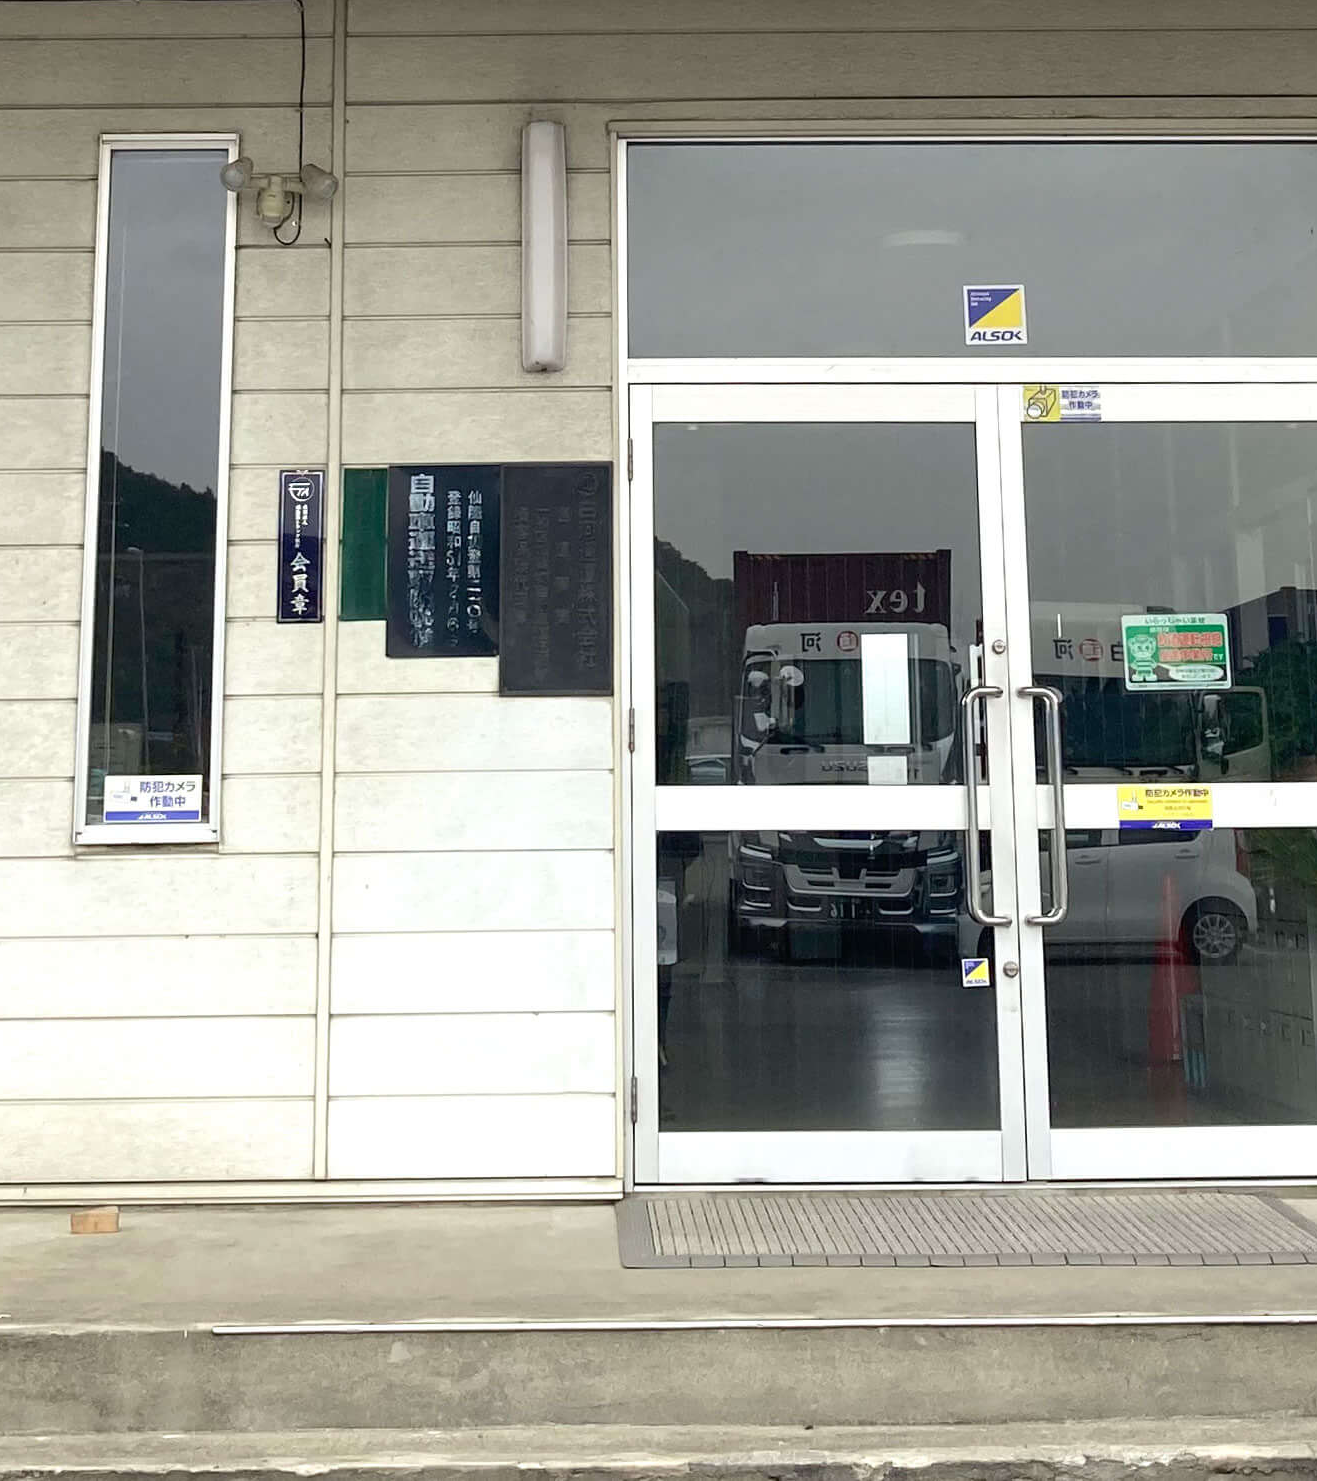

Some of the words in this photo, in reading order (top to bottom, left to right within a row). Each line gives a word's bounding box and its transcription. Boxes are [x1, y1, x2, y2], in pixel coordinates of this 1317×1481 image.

[970, 330, 1024, 342] ALSOK
[289, 551, 311, 616] 会員章
[140, 781, 195, 793] 防犯カメラ
[1145, 789, 1209, 797] 防犯カメラ作動中
[150, 795, 186, 807] 作動中
